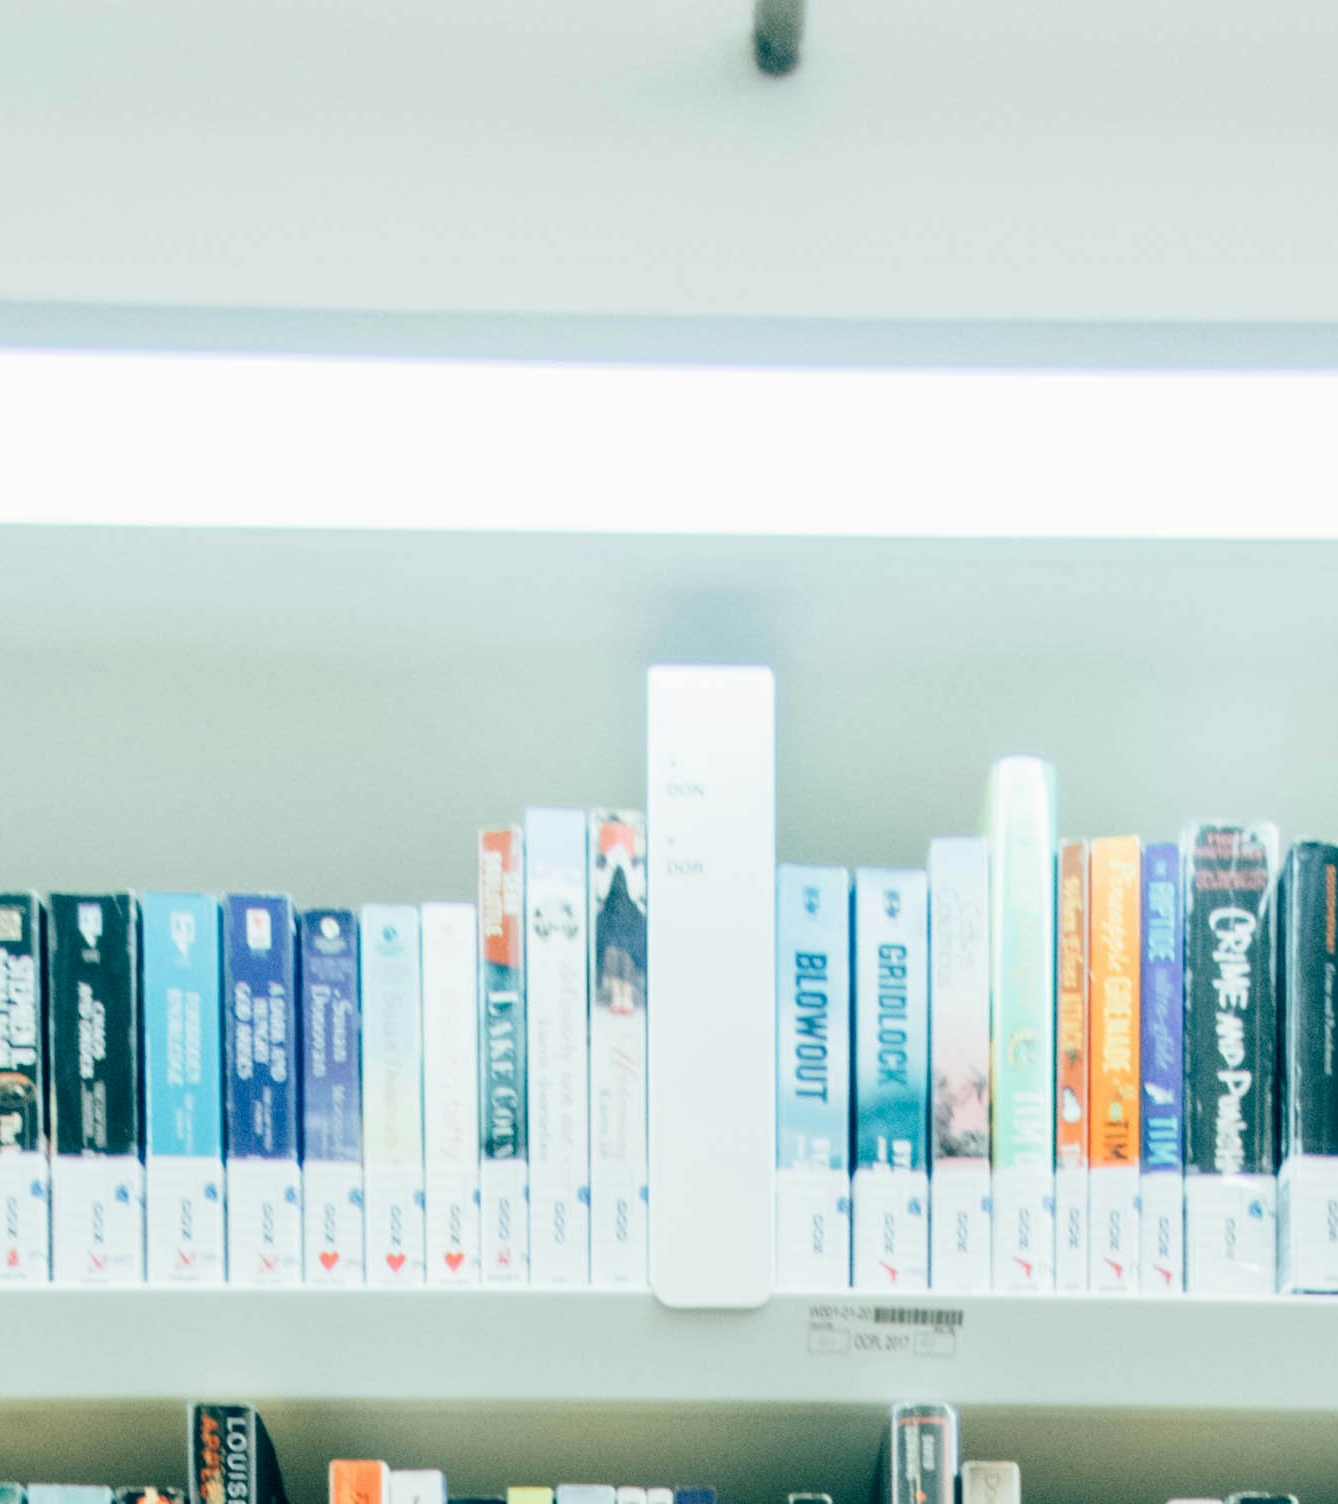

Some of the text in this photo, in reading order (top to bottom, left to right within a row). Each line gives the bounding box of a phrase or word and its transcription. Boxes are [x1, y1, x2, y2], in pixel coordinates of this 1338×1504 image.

[794, 951, 829, 1102] BLOWOUT
[876, 943, 908, 1091] GRIDLOCK
[1209, 905, 1252, 1010] CRIME
